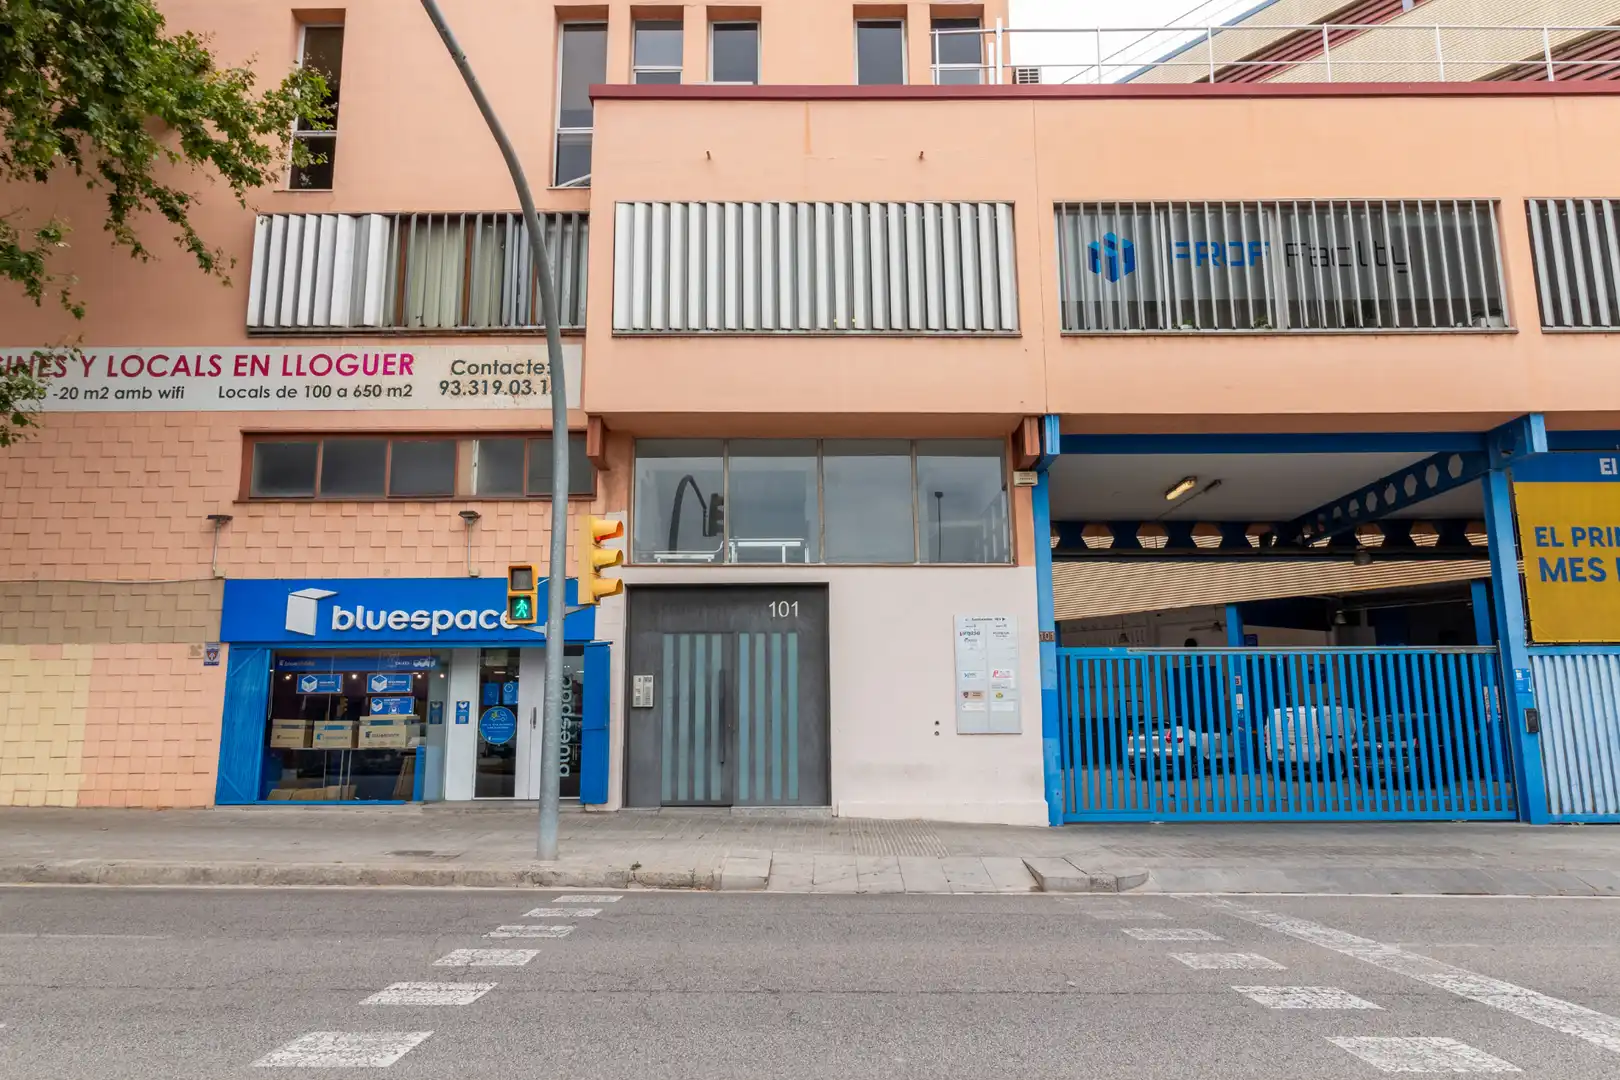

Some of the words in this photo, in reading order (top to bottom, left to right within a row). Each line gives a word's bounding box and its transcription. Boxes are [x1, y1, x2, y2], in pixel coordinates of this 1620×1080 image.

[0, 354, 68, 378] INES
[80, 355, 97, 377] Y
[107, 354, 222, 378] LOCALS
[233, 354, 270, 377] EN
[281, 353, 415, 377] LLOGUER
[83, 386, 110, 400] m2
[114, 386, 153, 400] amb
[158, 386, 185, 400] wifi
[218, 385, 270, 399] Locals
[276, 385, 298, 399] de
[304, 385, 332, 398] 100
[337, 388, 348, 398] a
[353, 384, 382, 398] 650
[387, 384, 413, 398] m2
[439, 380, 553, 396] 93.319.03.1
[1534, 526, 1565, 547] EL
[1571, 526, 1620, 547] PRI
[1538, 556, 1607, 582] MES
[768, 600, 799, 618] 101
